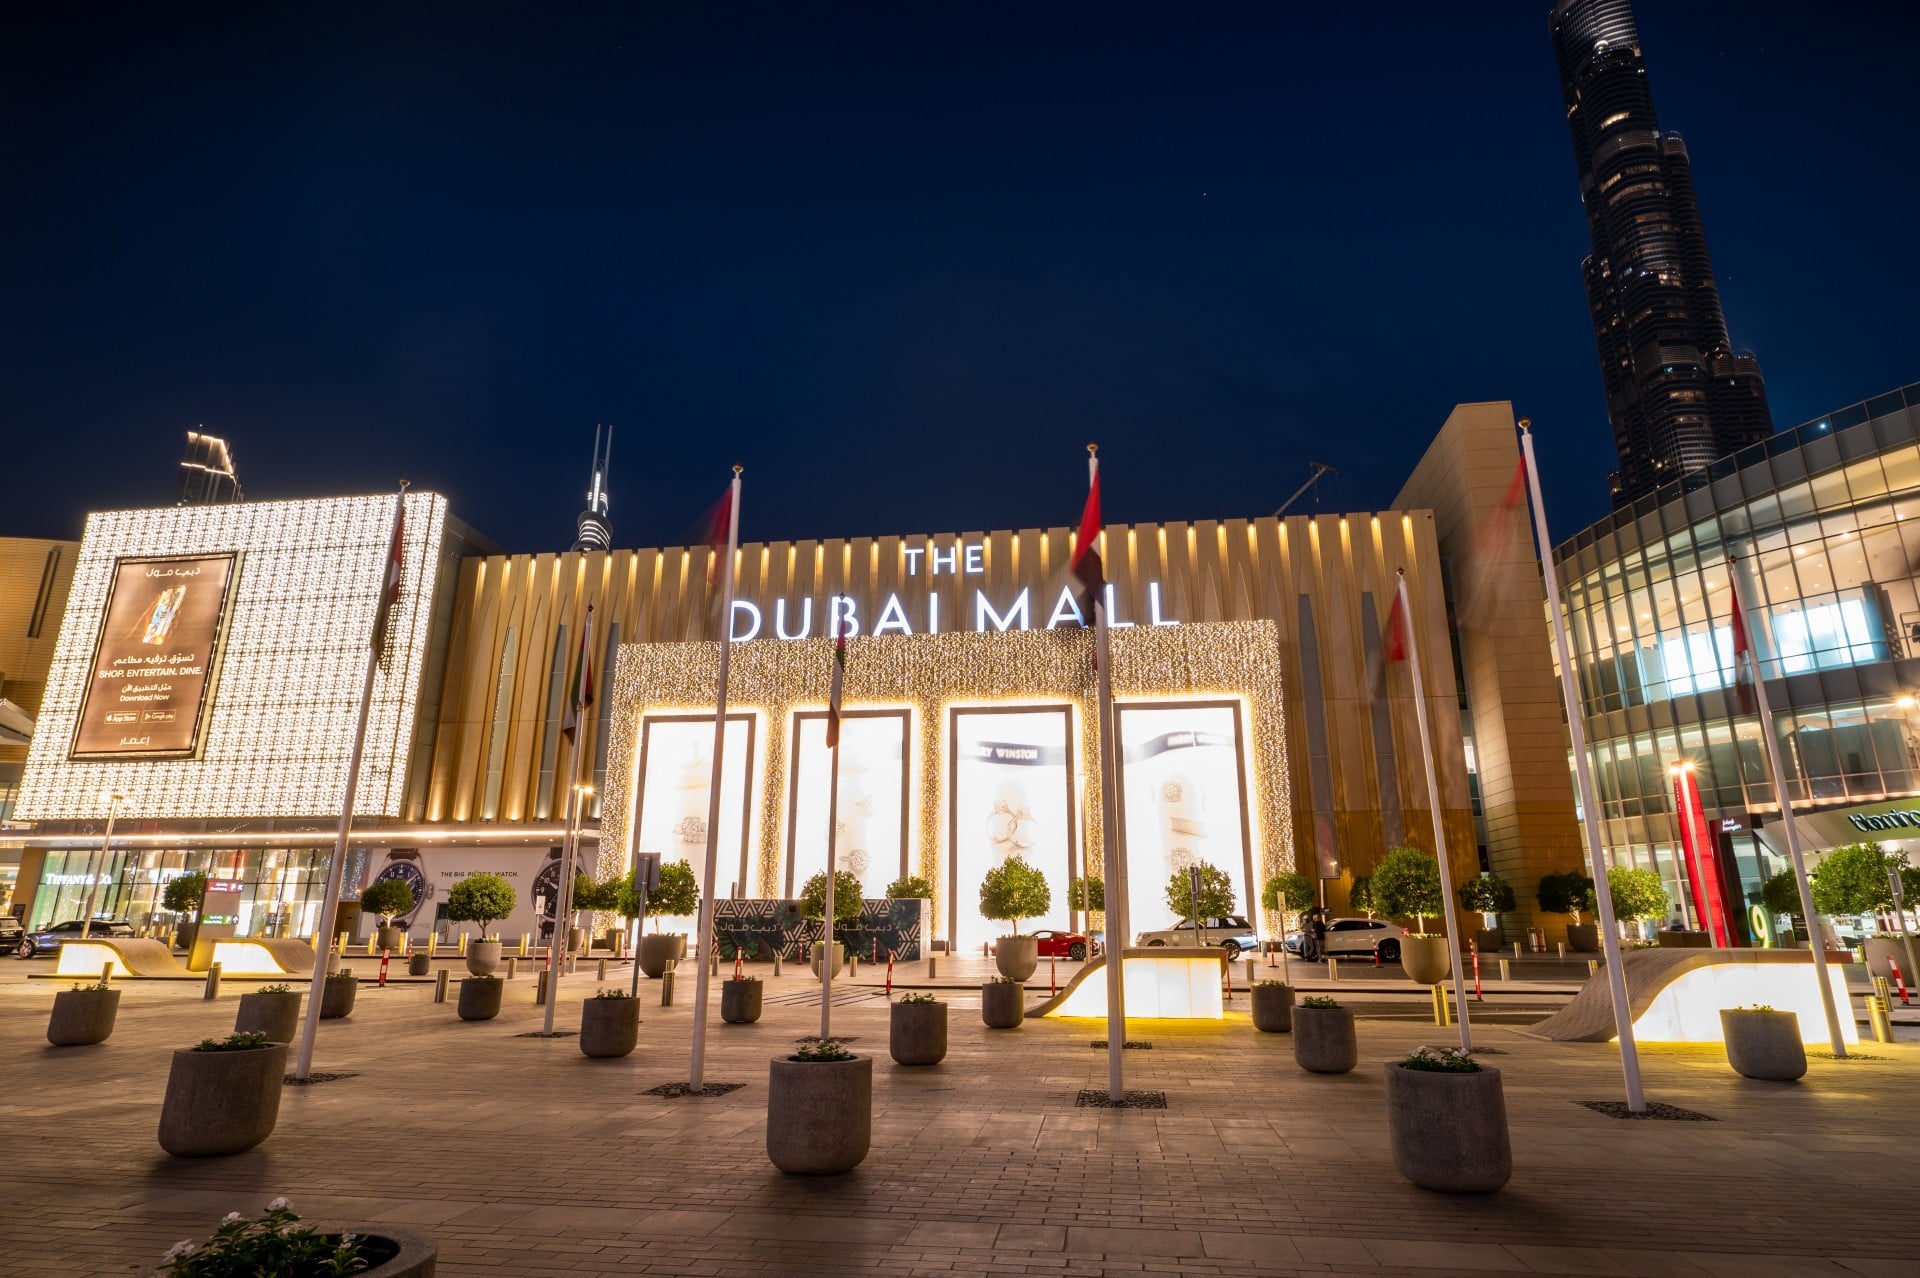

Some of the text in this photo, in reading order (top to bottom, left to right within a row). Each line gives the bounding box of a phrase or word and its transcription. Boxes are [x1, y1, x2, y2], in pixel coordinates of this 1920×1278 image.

[903, 545, 984, 576] THE
[145, 567, 201, 578] دبي مول
[730, 582, 1181, 642] DUBAI MALL
[98, 666, 203, 679] SHOP. ENTERTAIN. DINE.
[120, 694, 153, 702] Download
[120, 736, 151, 746] إعمار
[996, 748, 1038, 760] WINSTON
[46, 873, 88, 885] TIFFANY
